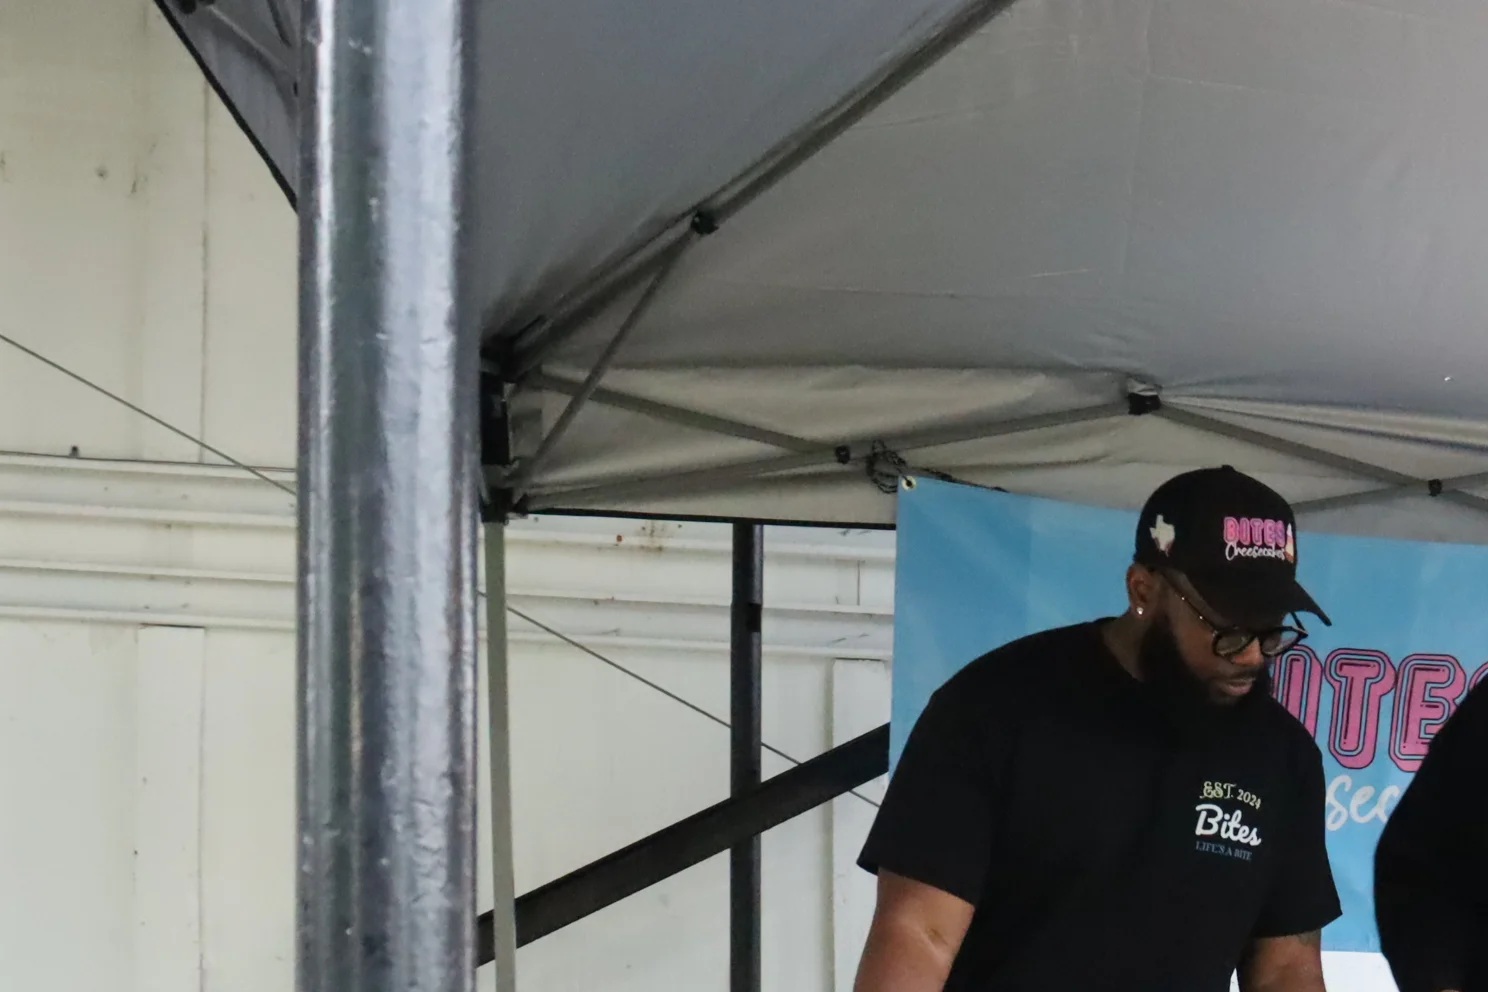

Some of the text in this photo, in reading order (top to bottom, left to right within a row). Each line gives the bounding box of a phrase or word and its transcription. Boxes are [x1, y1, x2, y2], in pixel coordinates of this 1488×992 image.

[1224, 516, 1286, 547] BITES
[1236, 789, 1261, 809] 2024
[1195, 803, 1262, 846] Bites
